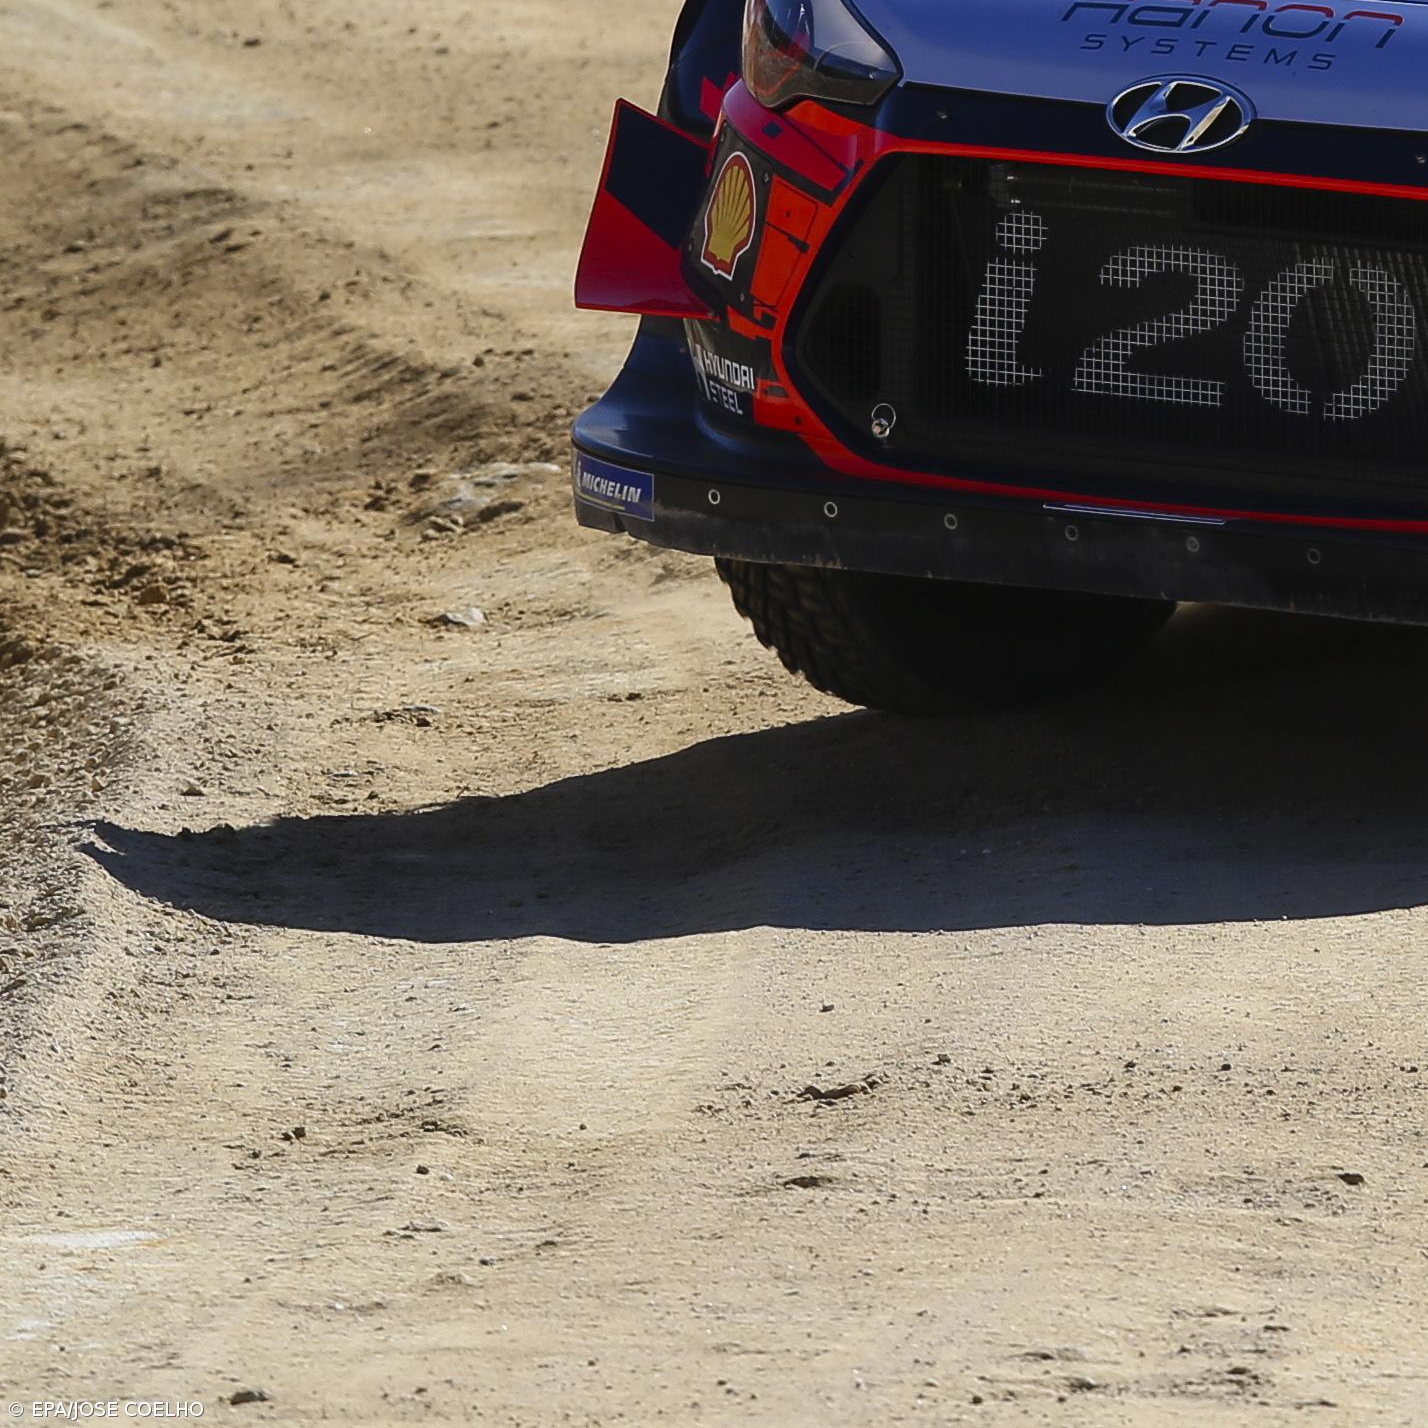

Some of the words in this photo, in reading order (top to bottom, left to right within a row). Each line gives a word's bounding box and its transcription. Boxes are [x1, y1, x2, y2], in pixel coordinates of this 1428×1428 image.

[1080, 33, 1337, 70] SYSTEMS
[962, 208, 1416, 420] i20
[703, 350, 755, 390] HYUNDAI
[710, 380, 744, 415] STEEL
[580, 470, 642, 504] MICHELIN
